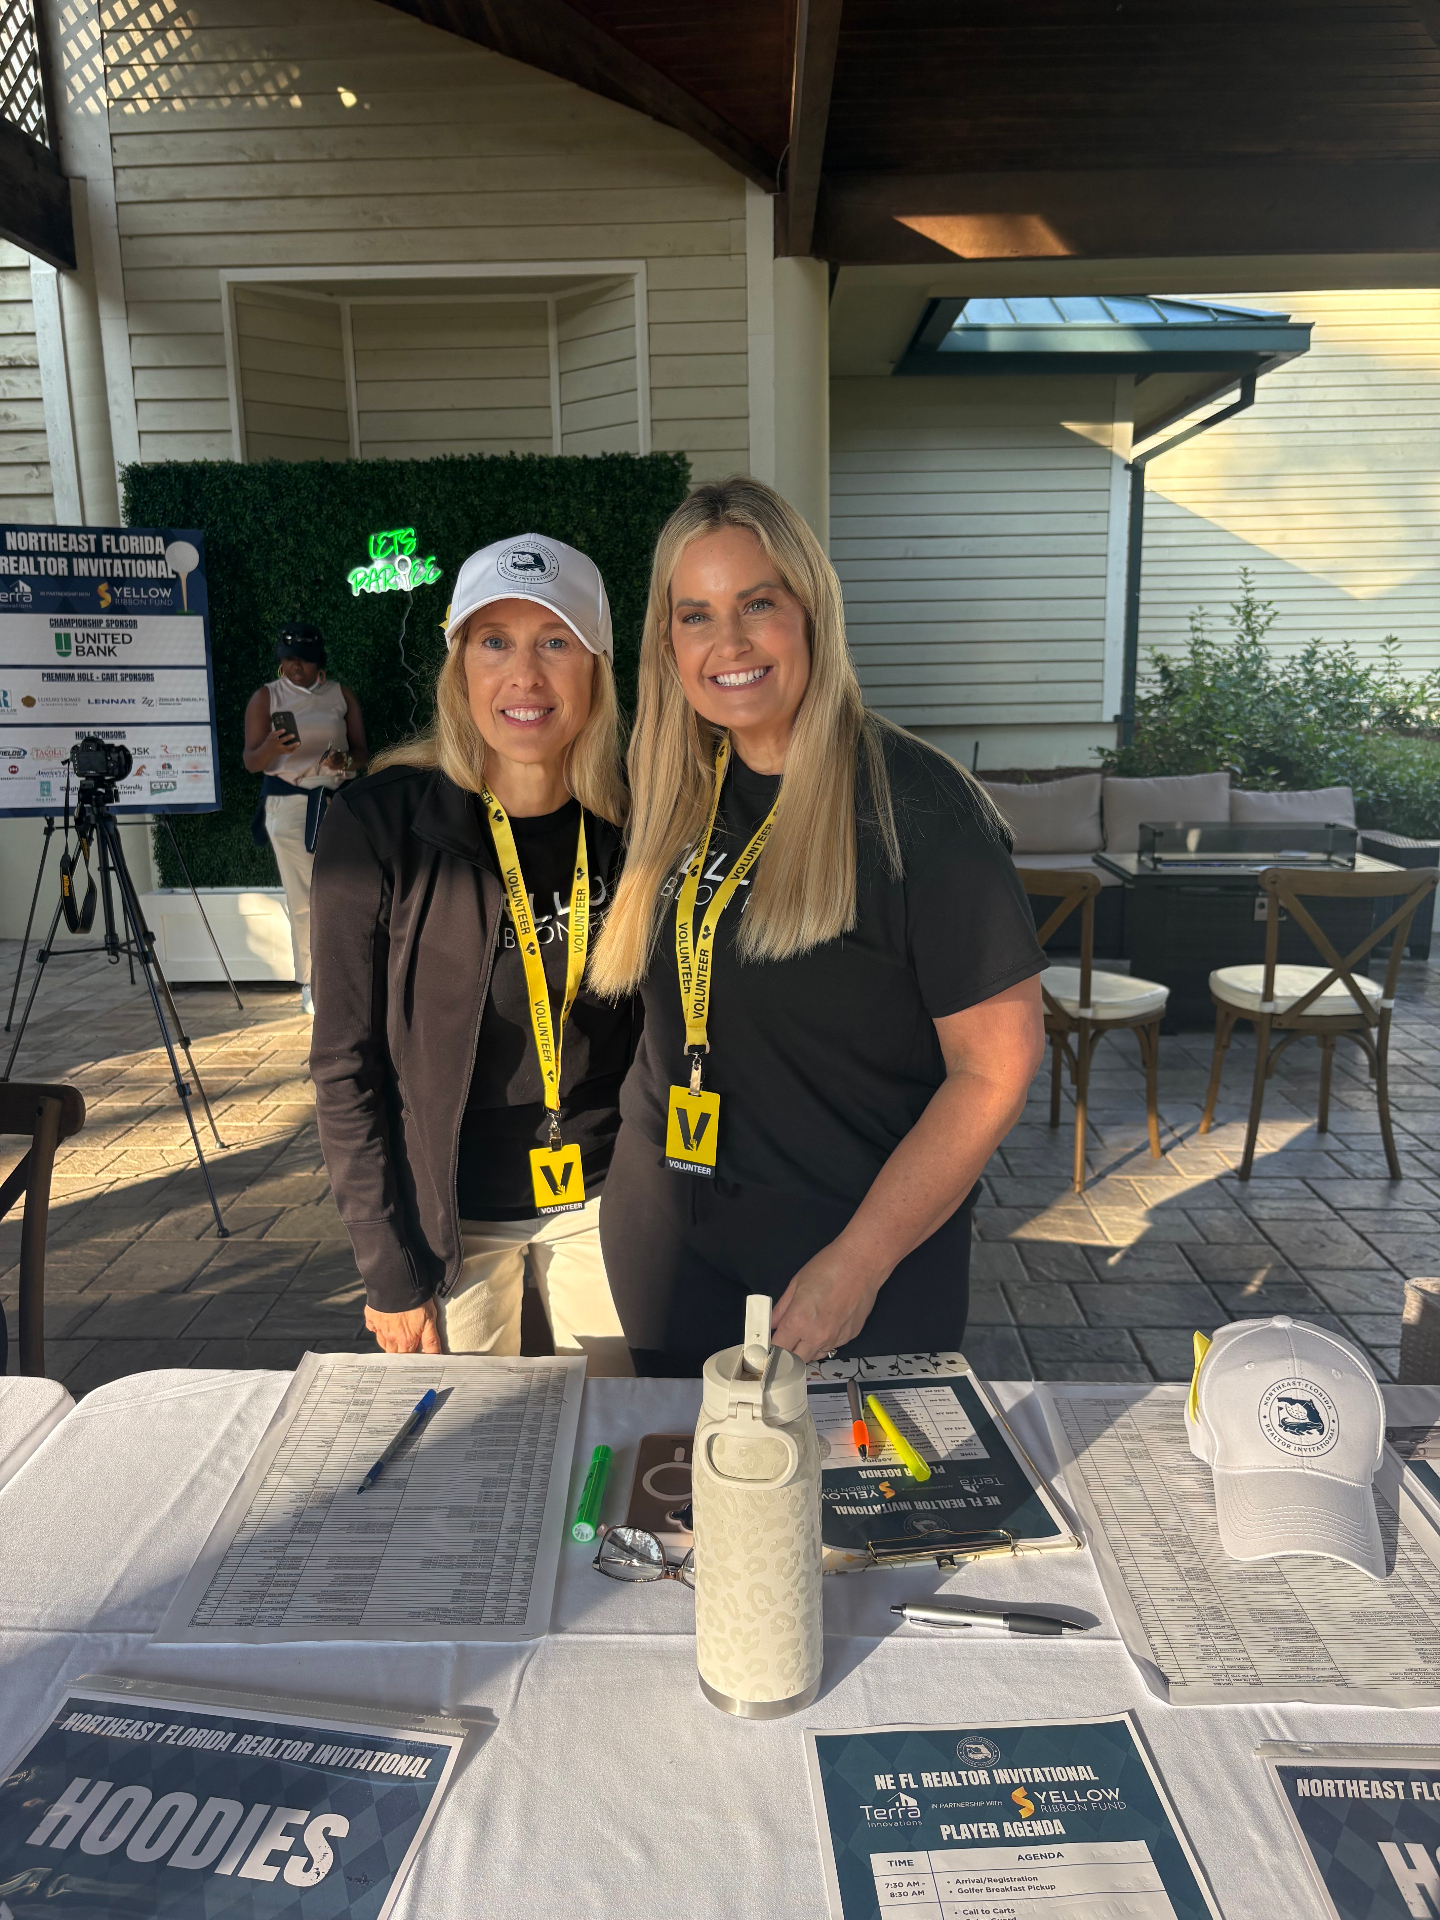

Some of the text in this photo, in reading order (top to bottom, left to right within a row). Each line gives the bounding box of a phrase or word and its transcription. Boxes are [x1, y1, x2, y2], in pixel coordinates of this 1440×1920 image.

[6, 531, 165, 554] NORTHEAST FLORIDA
[368, 527, 417, 559] LETS
[0, 556, 176, 578] REALTOR INVITATIONAL
[0, 592, 32, 602] erra
[114, 587, 172, 598] YELLOW
[50, 618, 138, 629] CHAMPIONSHIP SPONSOR
[74, 632, 132, 644] UNITED
[76, 646, 118, 657] BANK
[42, 672, 155, 682] PREMIUM HOLE CART SPONSORS
[75, 731, 126, 739] HOLE SPONSORS
[730, 823, 773, 881] VOLUNTEER
[506, 867, 531, 936] VOLUNTEER
[574, 888, 587, 954] VOLUNTEER
[693, 948, 710, 1020] VOLUNTEER
[532, 1000, 553, 1062] VOLUNTEER
[668, 1159, 712, 1176] VOLUNTEER
[541, 1202, 583, 1215] VOLUNTEER
[1264, 1381, 1332, 1410] NORTHEAST FLORIDA
[1265, 1423, 1335, 1453] REALTOR INVITATIONAL
[858, 1464, 945, 1479] PLR AGENDA
[840, 1484, 875, 1493] RIBBON
[960, 1478, 1004, 1490] Terra
[832, 1496, 1002, 1515] NE FL REALTOR INVITATIONAL
[59, 1712, 433, 1779] NORTHEAST FLORIDA REALTOR INVITATIONAL
[874, 1765, 1100, 1790] NE FL REALTOR INVITATIONAL
[1033, 1788, 1120, 1803] YELLOW
[1296, 1778, 1404, 1799] NORTHEAST
[860, 1805, 920, 1820] Terra
[1040, 1801, 1126, 1813] RIBBON FUND
[25, 1777, 349, 1887] HOODIES
[867, 1820, 923, 1828] Innovations
[940, 1819, 1066, 1841] PLAYER AGENDA
[1017, 1852, 1064, 1861] AGENDA
[955, 1876, 1039, 1885] Arrival/Registration
[1377, 1841, 1440, 1918] H
[957, 1884, 1056, 1895] Golfer Breakfast Pickup
